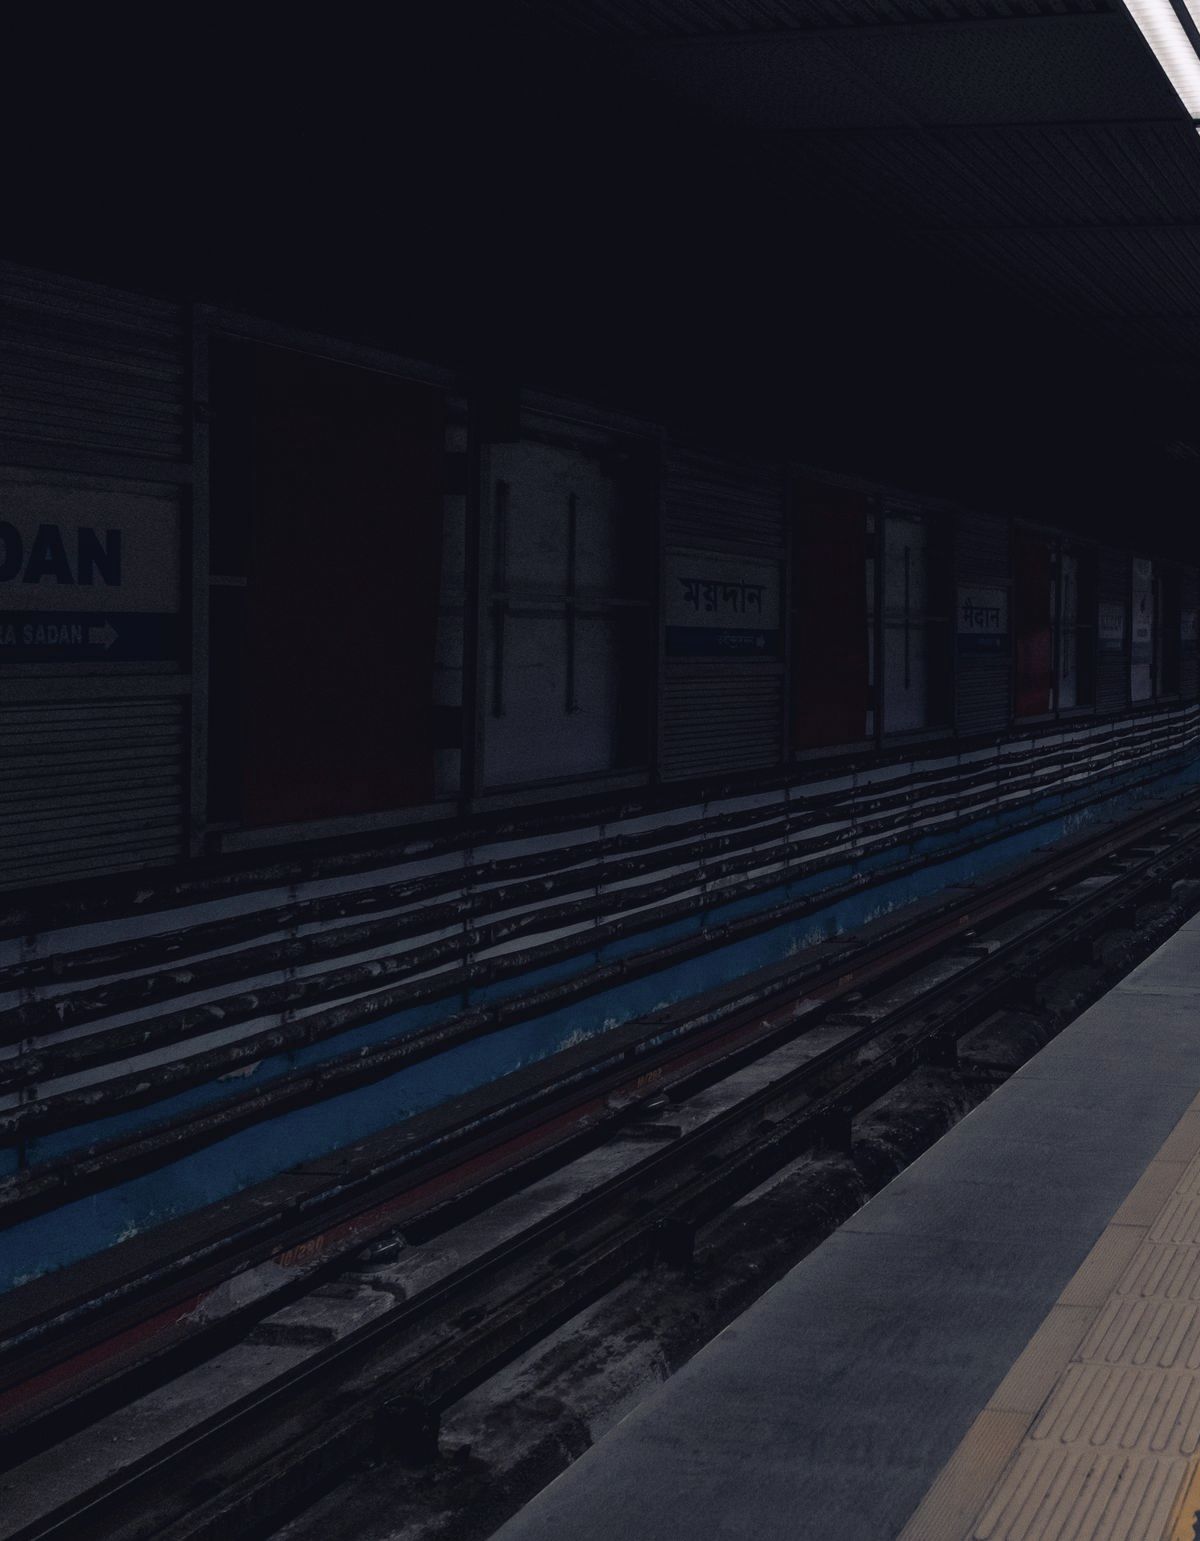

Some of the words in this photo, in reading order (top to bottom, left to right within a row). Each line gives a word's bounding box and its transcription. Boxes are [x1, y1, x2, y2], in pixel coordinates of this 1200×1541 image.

[676, 577, 768, 614] ময়দান
[961, 596, 1001, 629] मैदान
[22, 623, 83, 645] SADAN
